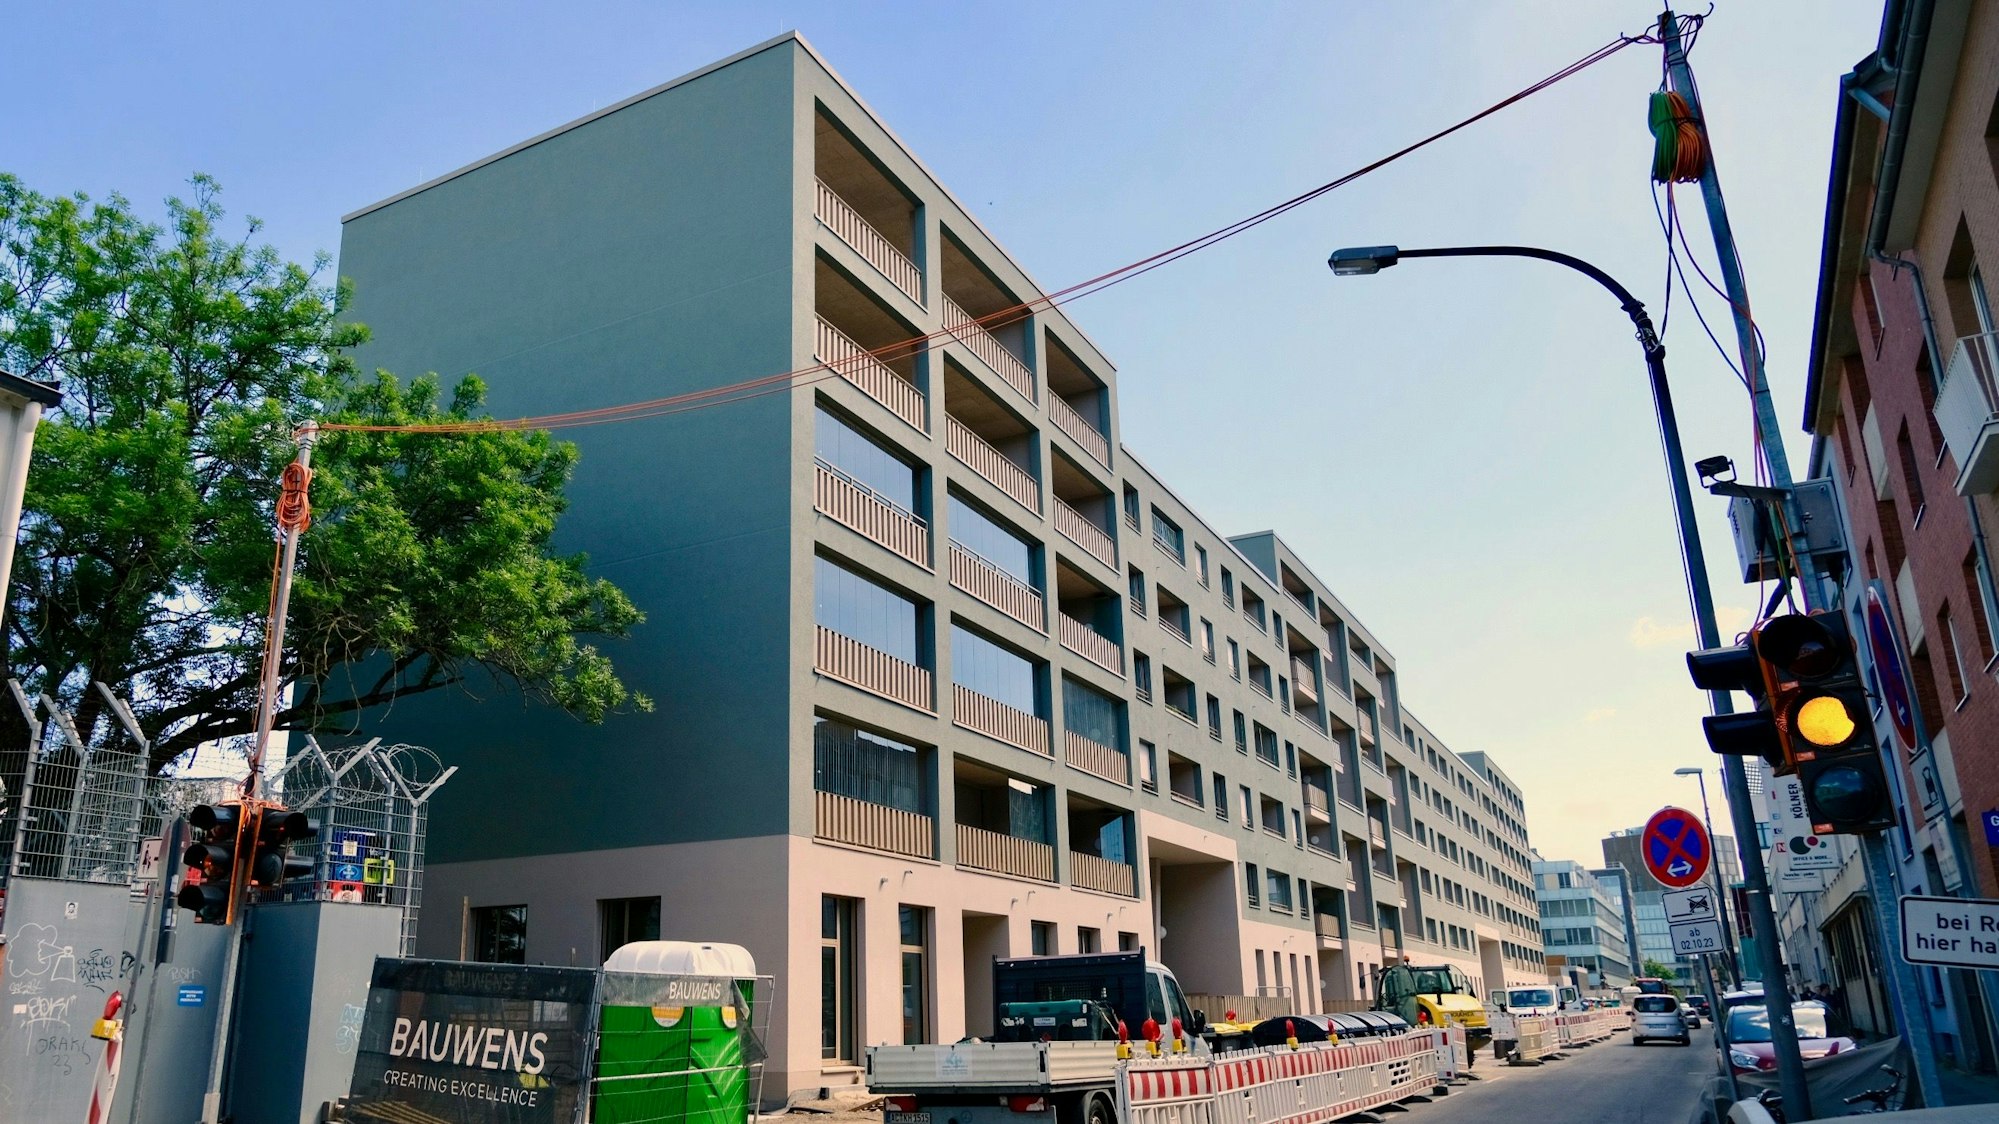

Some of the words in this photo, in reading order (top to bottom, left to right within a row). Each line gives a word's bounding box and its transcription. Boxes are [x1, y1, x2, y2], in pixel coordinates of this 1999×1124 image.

[1787, 782, 1804, 819] KÖLNER
[1936, 913, 1969, 931] bei
[1689, 927, 1701, 937] ab
[1680, 937, 1714, 950] 02.10.23
[1916, 933, 1961, 951] hier
[668, 981, 722, 1000] BAUWENS
[389, 1017, 549, 1075] BAUWENS
[383, 1069, 448, 1094] CREATING
[450, 1080, 538, 1108] EXCELLENCE
